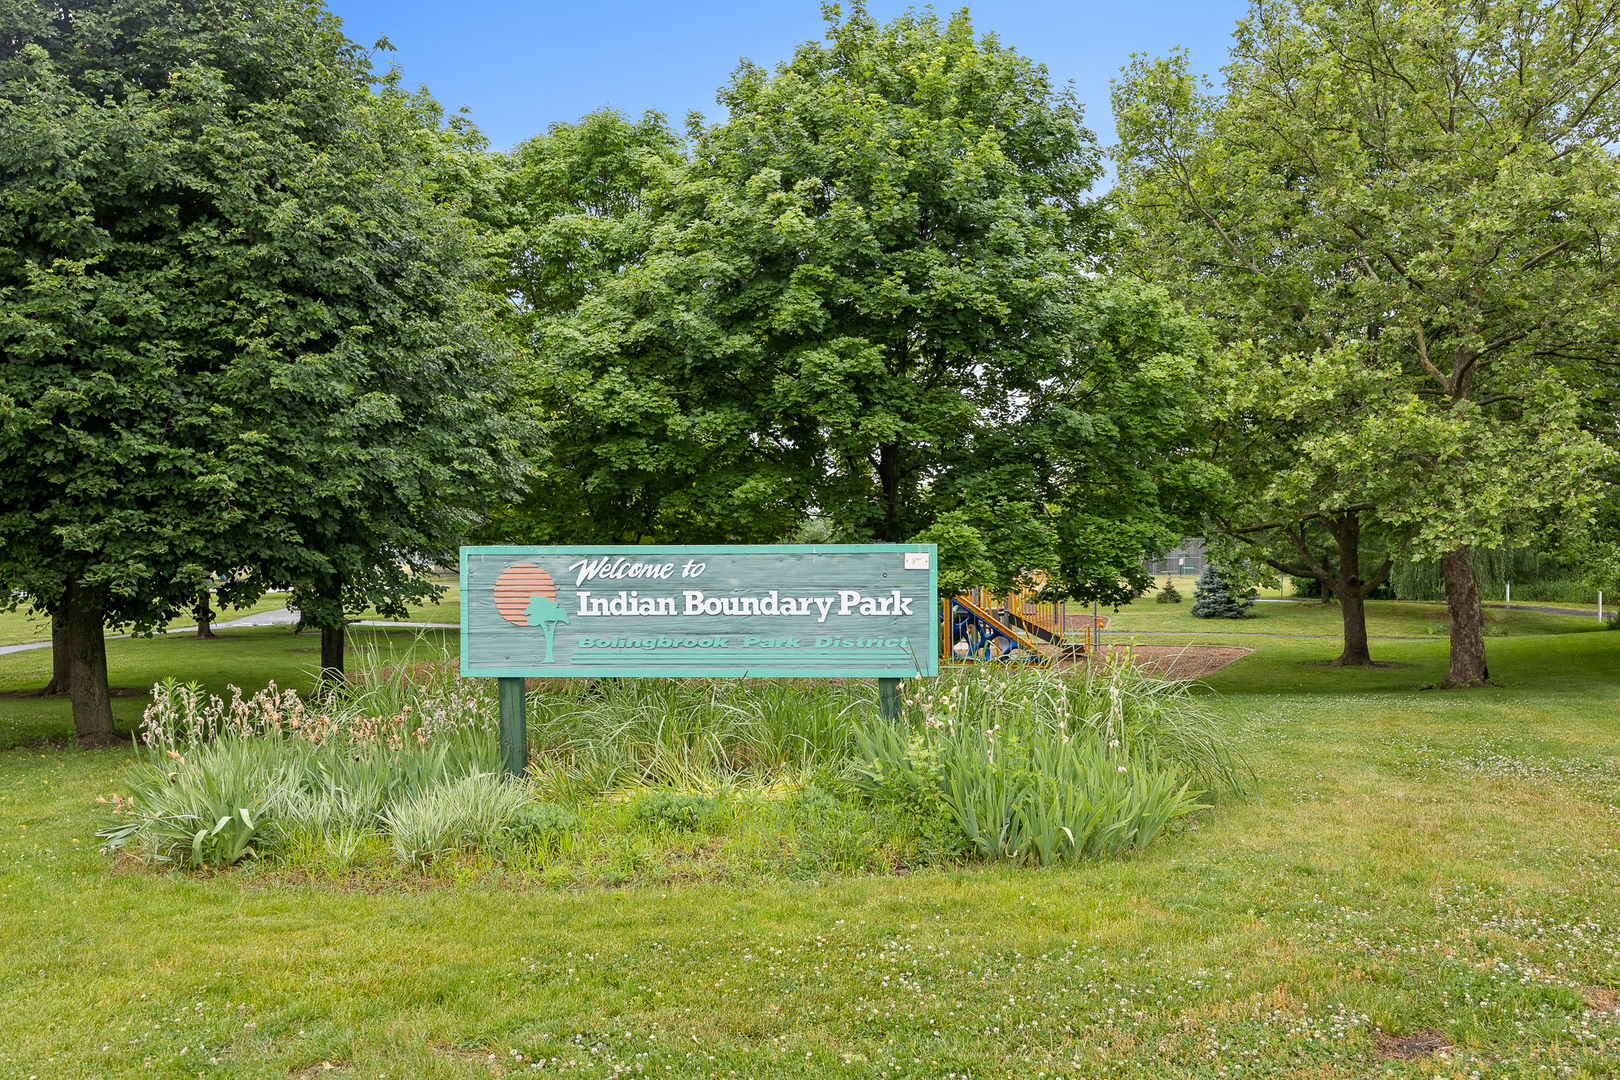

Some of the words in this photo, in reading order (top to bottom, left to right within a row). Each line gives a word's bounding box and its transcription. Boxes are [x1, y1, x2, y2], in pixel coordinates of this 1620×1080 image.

[568, 556, 675, 588] Welcome
[681, 559, 707, 579] to
[576, 590, 678, 616] Indian
[682, 590, 835, 623] Boundary
[837, 590, 914, 616] Park
[577, 636, 730, 650] Bolingbrook
[742, 636, 802, 648] Park
[814, 636, 909, 648] District
